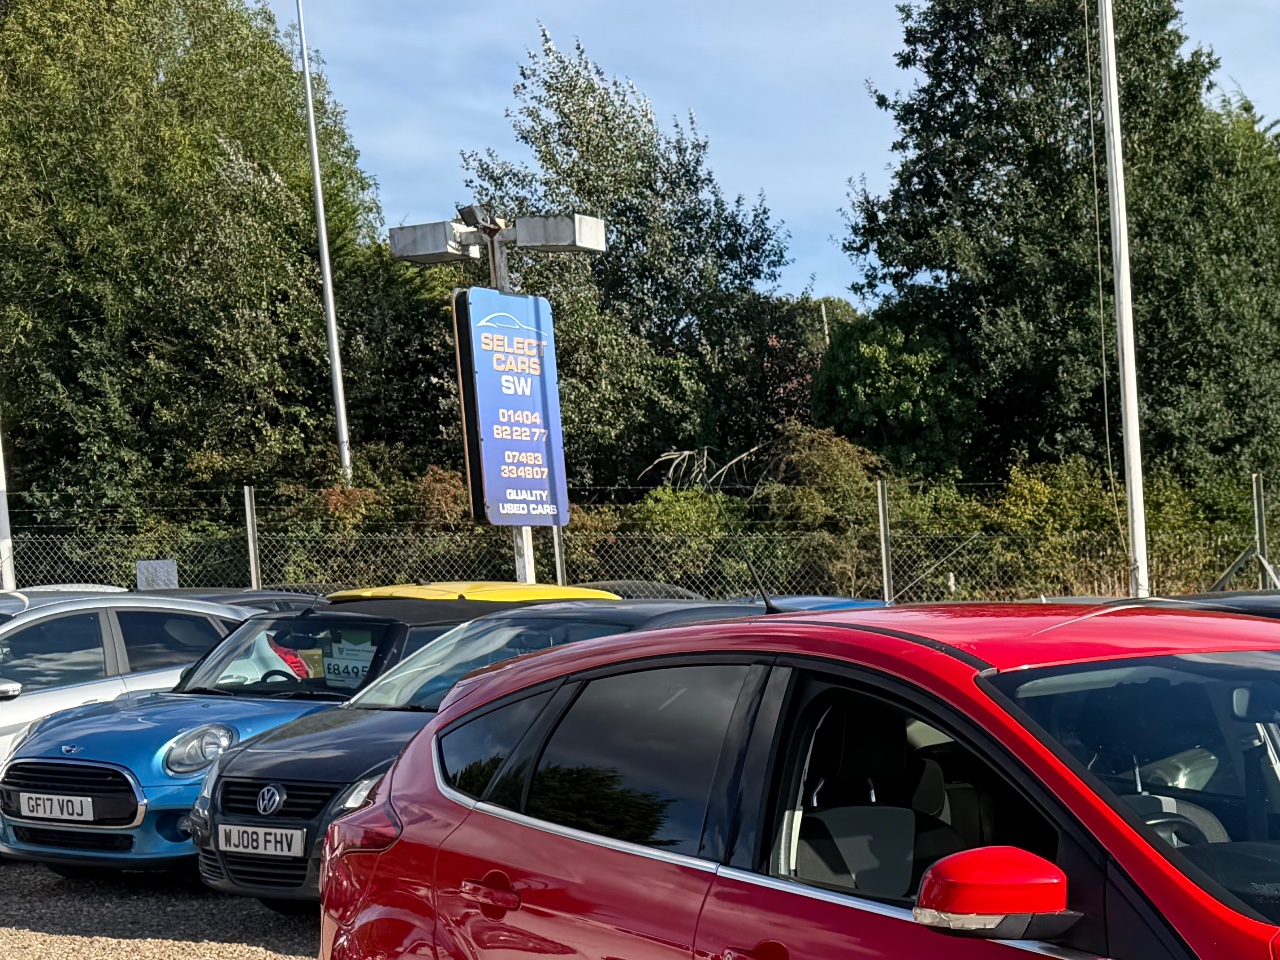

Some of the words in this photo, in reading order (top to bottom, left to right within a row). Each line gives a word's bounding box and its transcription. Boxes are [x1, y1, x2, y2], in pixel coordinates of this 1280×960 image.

[481, 332, 548, 357] SELECT
[493, 353, 542, 376] CARS
[501, 375, 532, 396] SW
[499, 408, 541, 425] 01404
[504, 451, 543, 465] 07483
[500, 465, 549, 479] 334807
[506, 488, 549, 501] QUALITY
[499, 503, 528, 514] USED
[529, 504, 557, 515] CARS
[326, 663, 368, 678] £8495
[27, 796, 53, 815] GF17
[57, 798, 84, 817] VOJ
[224, 828, 260, 850] WJ08
[263, 831, 294, 852] FHV
